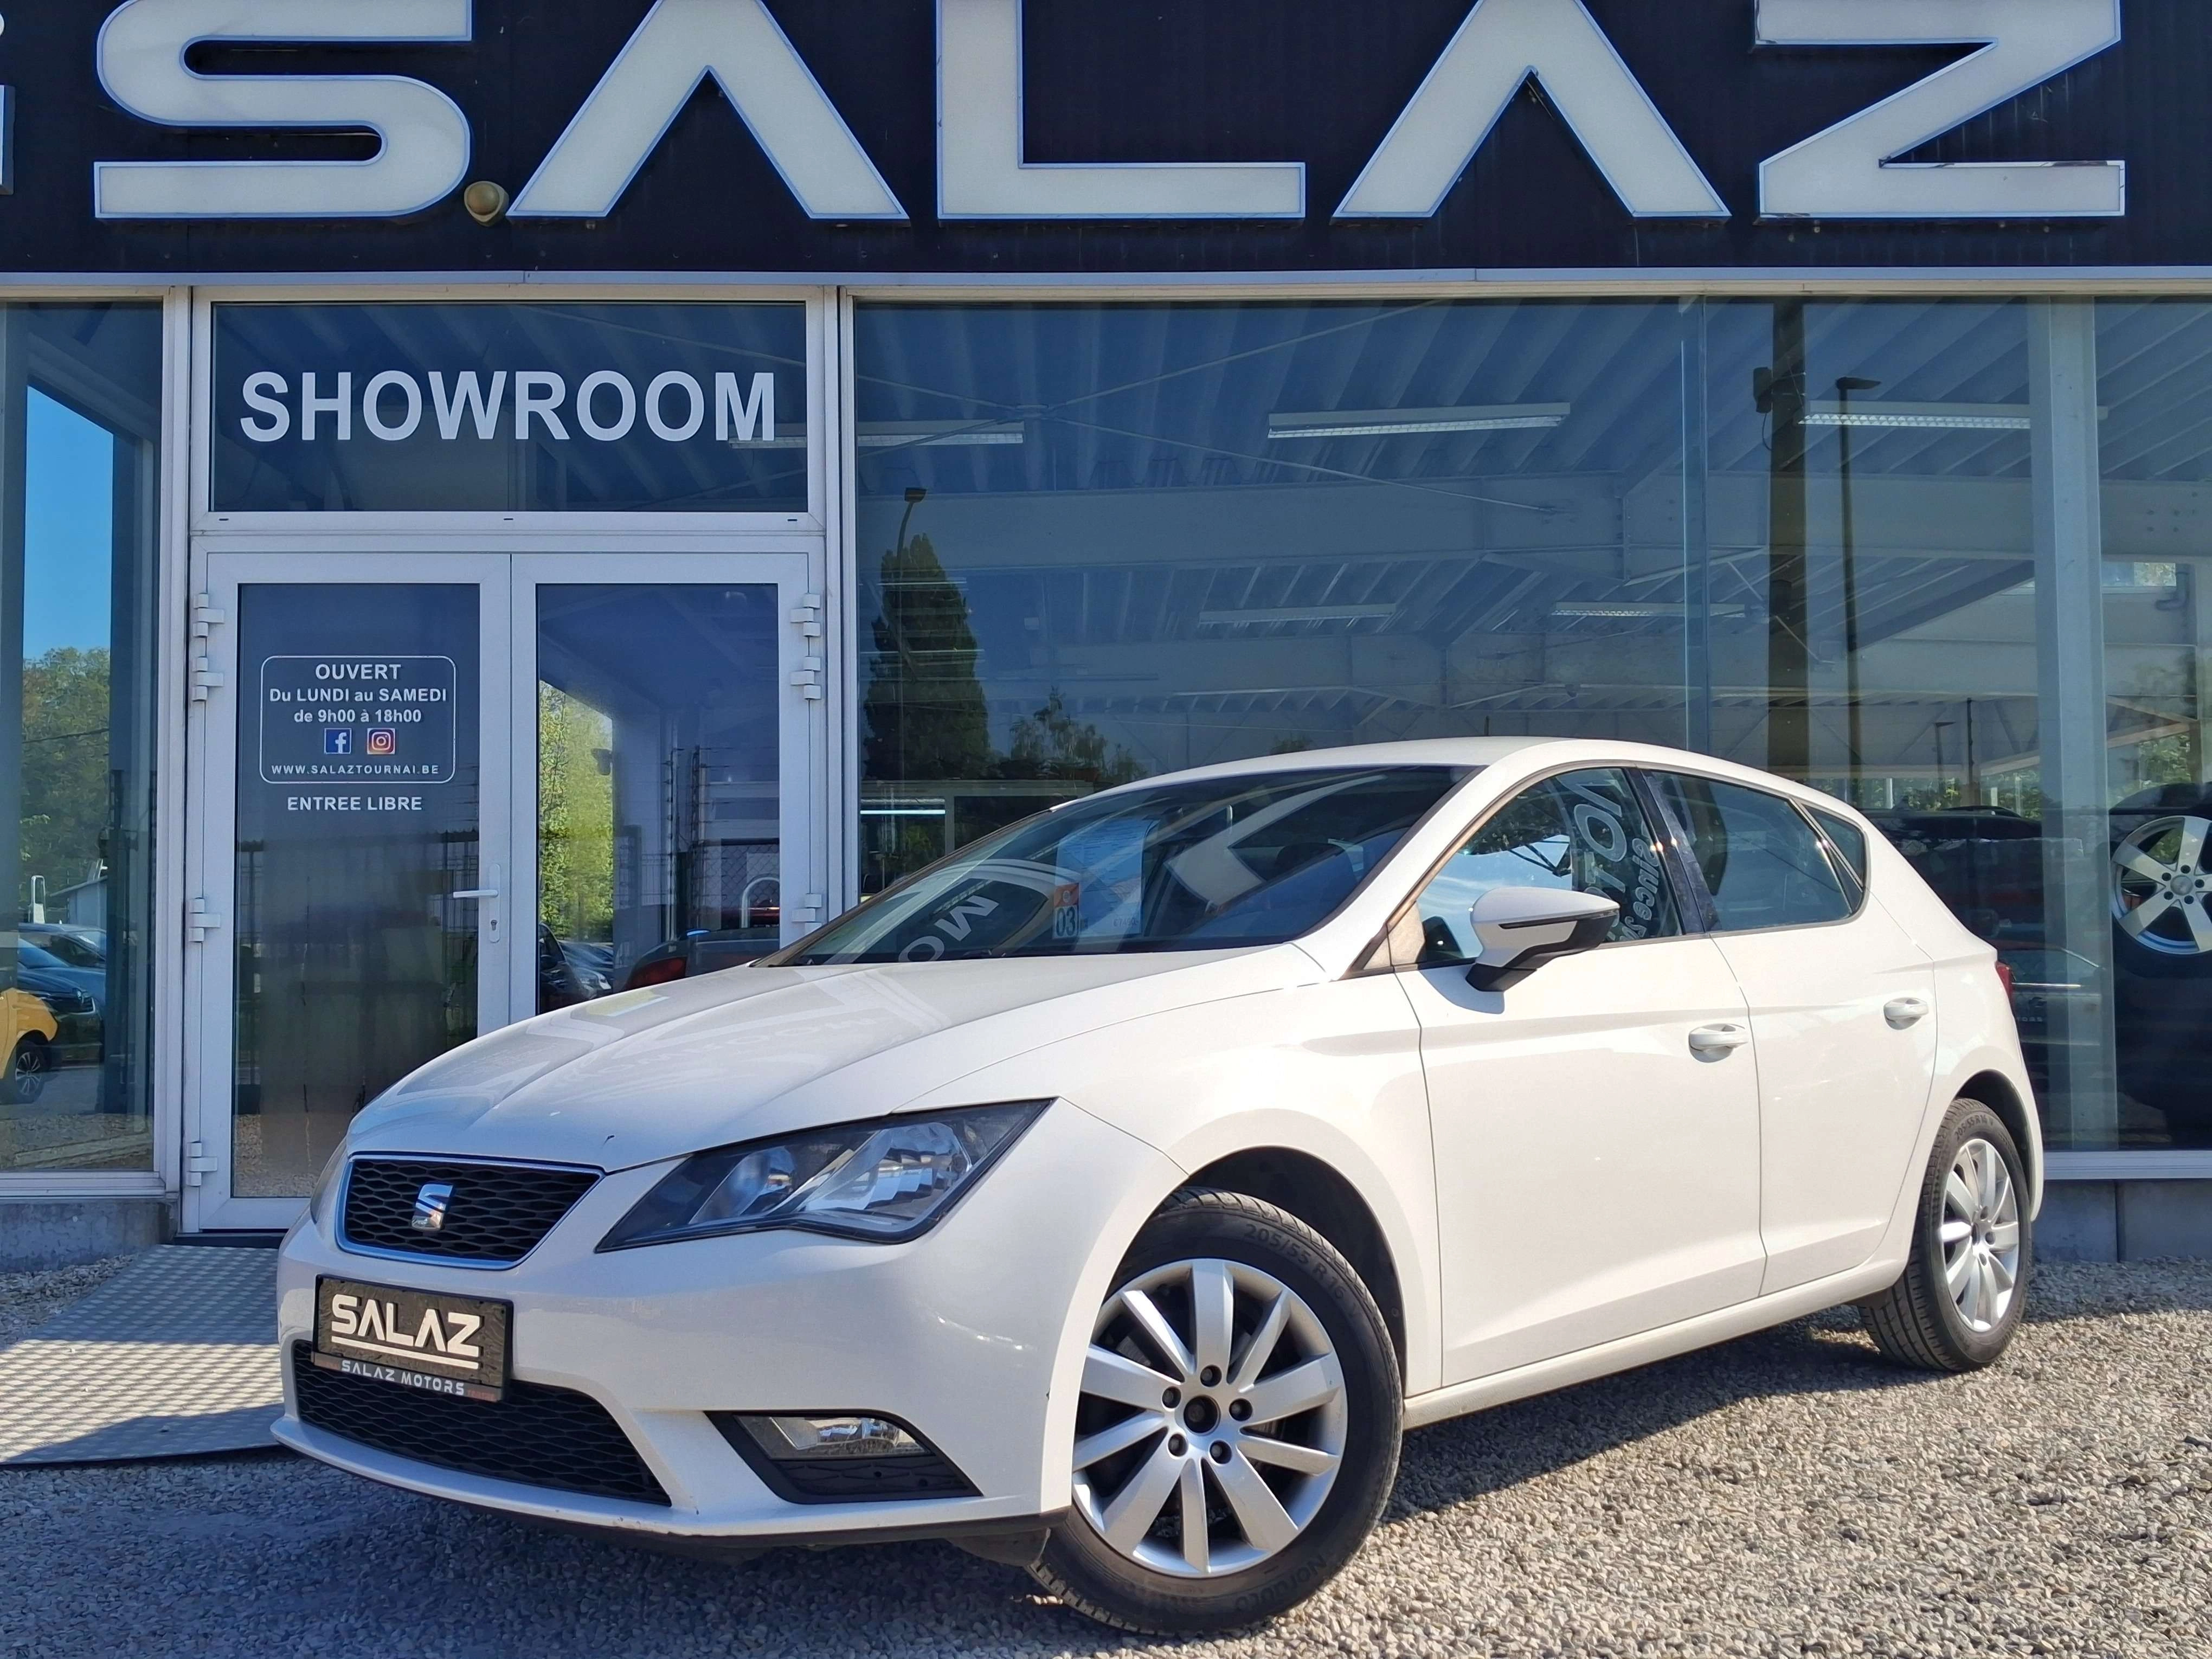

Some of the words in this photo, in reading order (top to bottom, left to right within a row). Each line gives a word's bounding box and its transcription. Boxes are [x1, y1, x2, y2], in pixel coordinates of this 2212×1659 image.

[93, 0, 2125, 221] SALAZ
[240, 371, 775, 442] SHOWROOM
[316, 664, 401, 680] OUVERT
[270, 689, 291, 702] Du
[297, 689, 349, 702] LUNDI
[355, 691, 373, 702] au
[379, 688, 446, 702] SAMEDI
[294, 710, 313, 723] de
[318, 709, 355, 723] 9h00
[360, 709, 369, 723] à
[375, 709, 421, 723] 18h00
[271, 765, 439, 774] WWW.SALAZTOURNAI.BE
[287, 797, 361, 811] ENTREE
[368, 797, 422, 811] LIBRE
[1056, 906, 1076, 937] 03
[1245, 1224, 1311, 1264] 205/55
[331, 1294, 481, 1358] SALAZ
[342, 1360, 395, 1382] SALAZ
[401, 1372, 464, 1396] MOTORS
